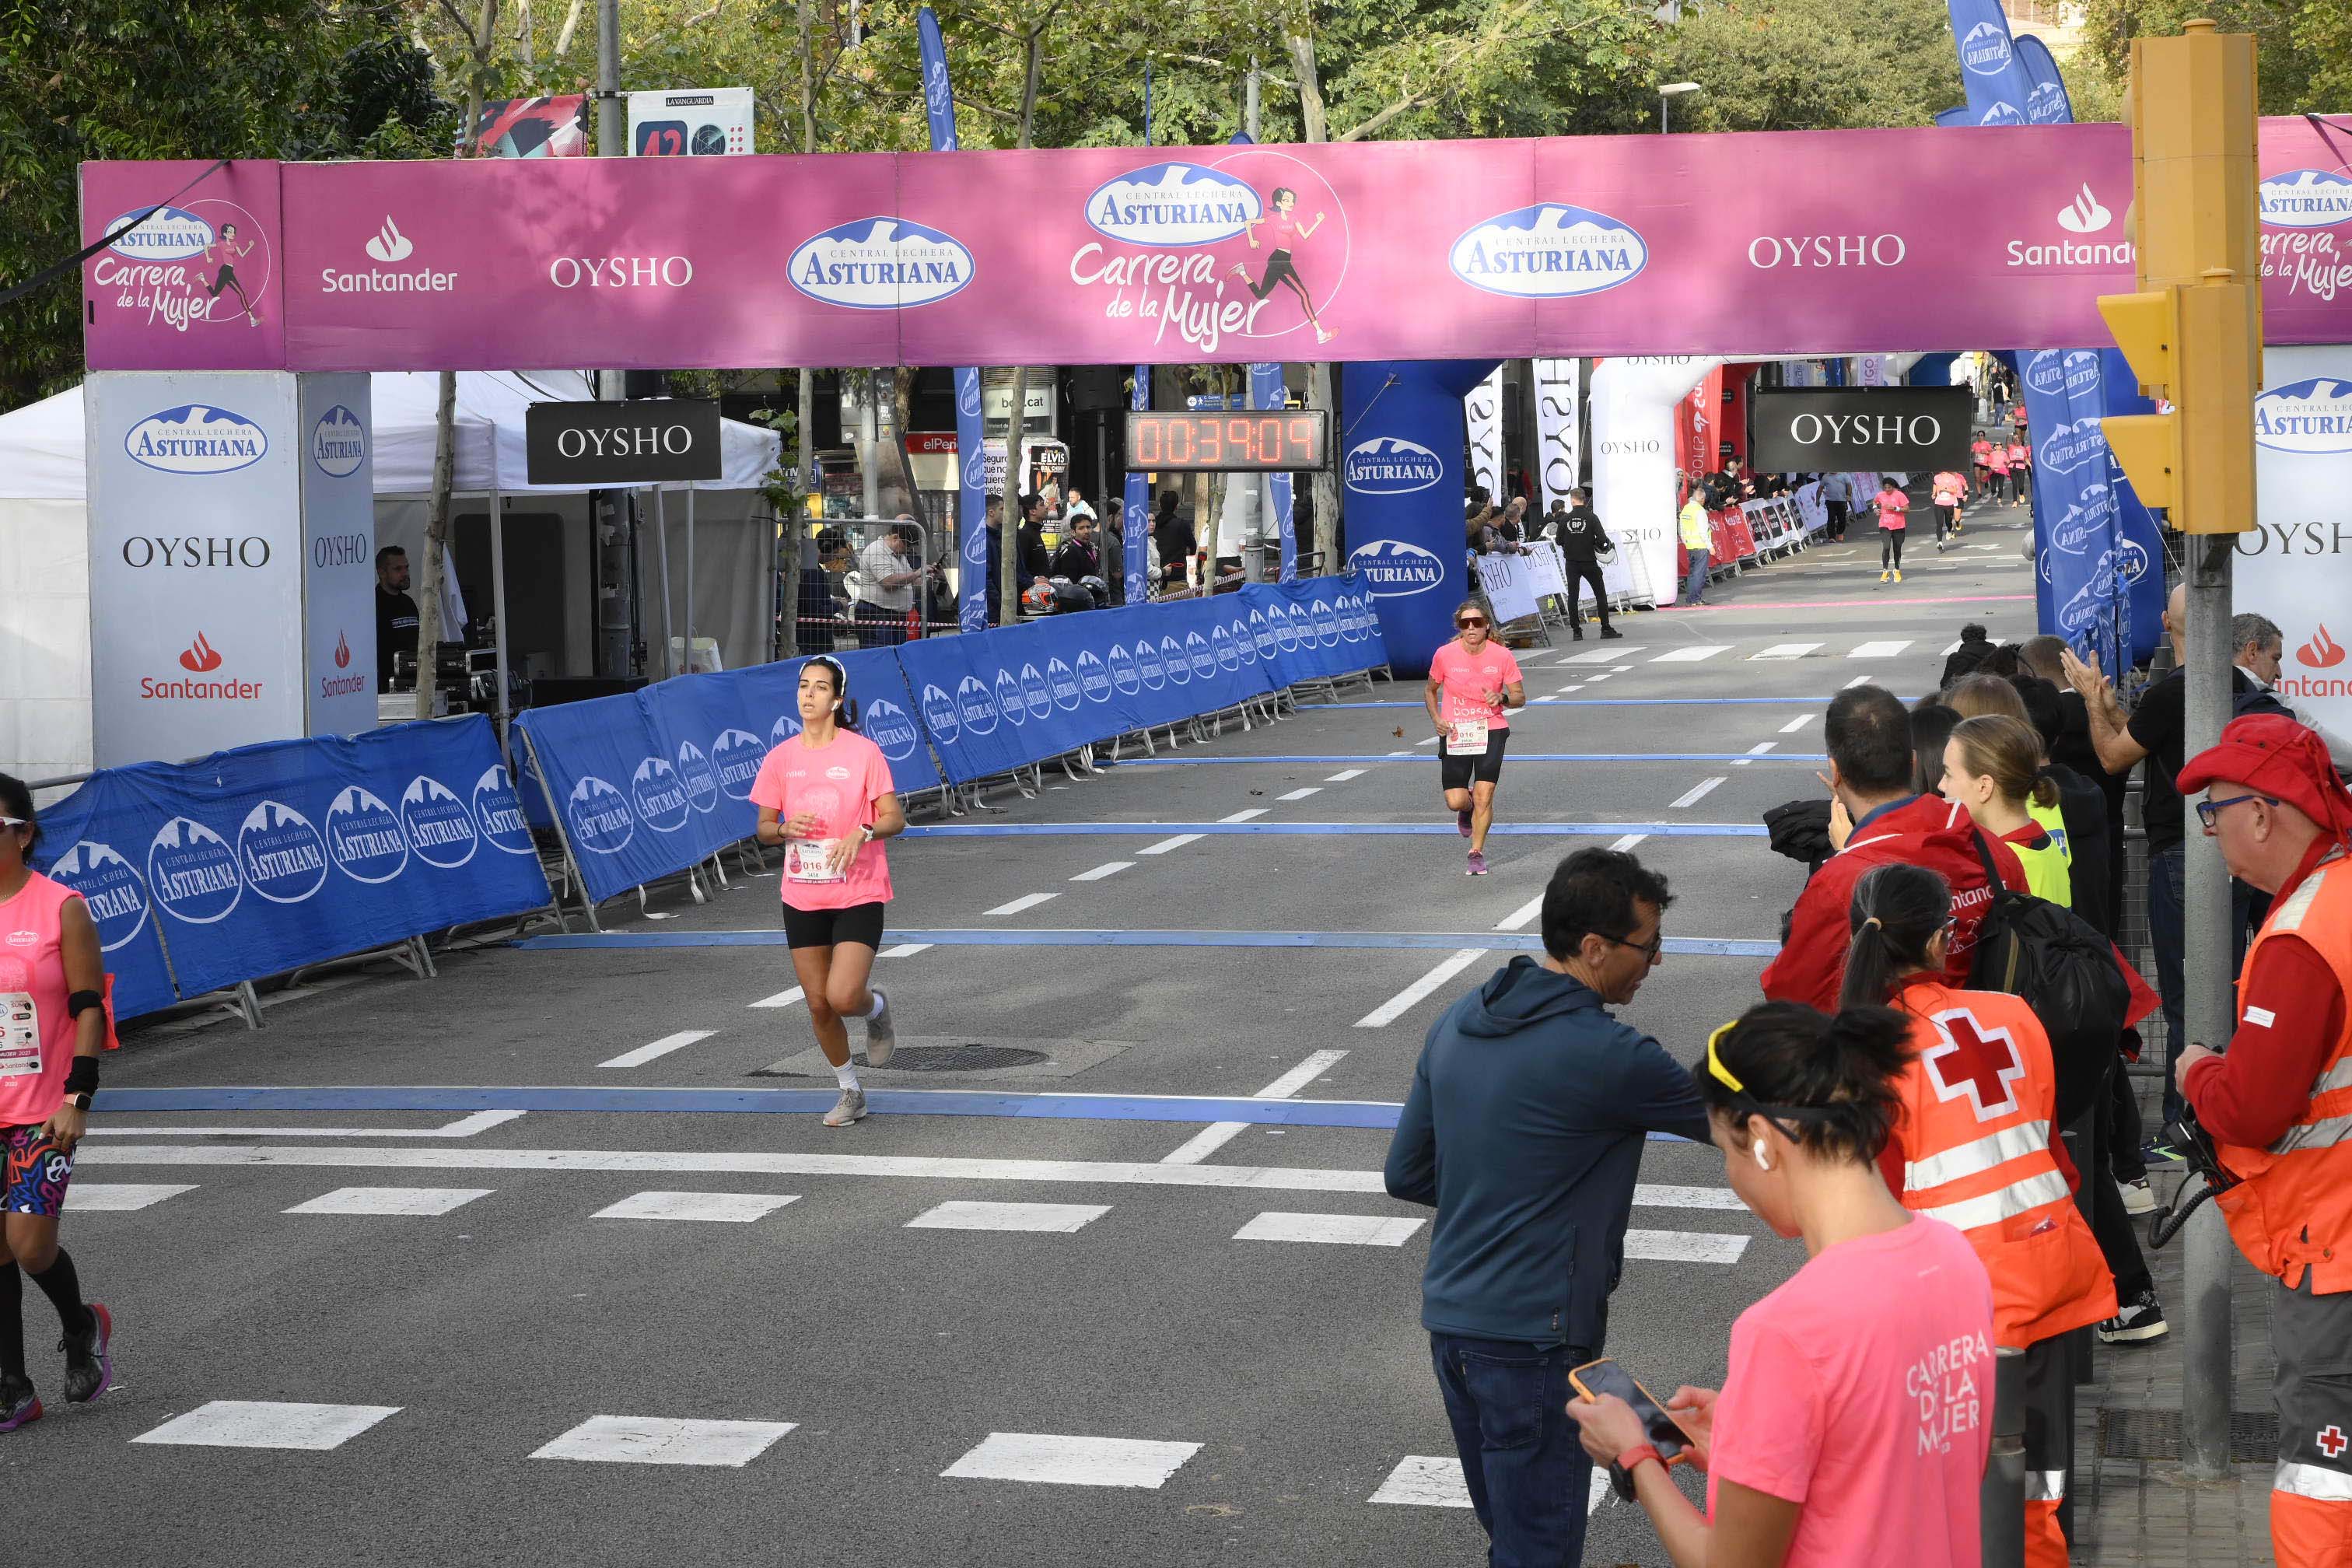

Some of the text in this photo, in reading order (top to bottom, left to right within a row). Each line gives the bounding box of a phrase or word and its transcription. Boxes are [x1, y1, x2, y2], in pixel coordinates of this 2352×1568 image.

[1125, 190, 1244, 201] CENTRAL LECHERA
[1098, 194, 1248, 226] ASTURIANA
[111, 226, 206, 247] ASTURIANA
[1495, 234, 1627, 246] CENTRAL LECHERA
[2260, 233, 2335, 254] arrera
[830, 248, 954, 258] CENTRAL LECHERA
[1069, 242, 1216, 286] Carrera
[1465, 240, 1633, 274] ASTURIANA
[1748, 233, 1906, 268] OYSHO
[2007, 240, 2135, 266] Santand
[94, 257, 186, 286] Carrera
[322, 268, 458, 292] Santander
[549, 256, 693, 289] OYSHO
[801, 252, 960, 286] ASTURIANA
[2278, 255, 2293, 277] la
[2288, 250, 2352, 301] Muje
[117, 283, 220, 332] de la Mujer
[1105, 278, 1270, 354] de la Mujer
[2277, 404, 2329, 412] CENTRAL
[557, 425, 692, 458] OYSHO
[923, 436, 958, 450] elPeri
[1790, 413, 1941, 446] OYSHO
[136, 430, 257, 457] ASTURIANA
[317, 433, 362, 460] ASTURIANA
[1601, 439, 1660, 455] OYSHO
[1041, 452, 1065, 463] ELVIS
[1348, 460, 1436, 481] ASTURIANA
[984, 474, 1008, 485] quiere
[985, 485, 1003, 495] mete
[122, 536, 271, 568] OYSHO
[314, 533, 366, 568] OYSHO
[2234, 522, 2352, 556] OYSH
[1365, 567, 1437, 583] TURIANA
[141, 677, 263, 699] Santander
[321, 673, 365, 698] Santander
[1081, 671, 1109, 691] ASTURIANA
[2273, 674, 2352, 698] antan
[1453, 696, 1465, 705] TU
[1453, 708, 1494, 716] DORSAL
[717, 759, 765, 786] ASTURIAN
[341, 819, 369, 831] CENTRAL
[408, 814, 474, 849] ASTURIANA
[480, 802, 527, 835] ASTUR
[254, 830, 312, 849] CENTRAL LECHERA
[334, 825, 404, 863] ASTURIANA
[246, 844, 324, 883] ASTURIANA
[803, 861, 822, 870] 016
[157, 859, 238, 902] ASTURIANA
[85, 884, 142, 924] URIANA
[1906, 1328, 1990, 1398] CARRERA
[1945, 1368, 1976, 1404] LA
